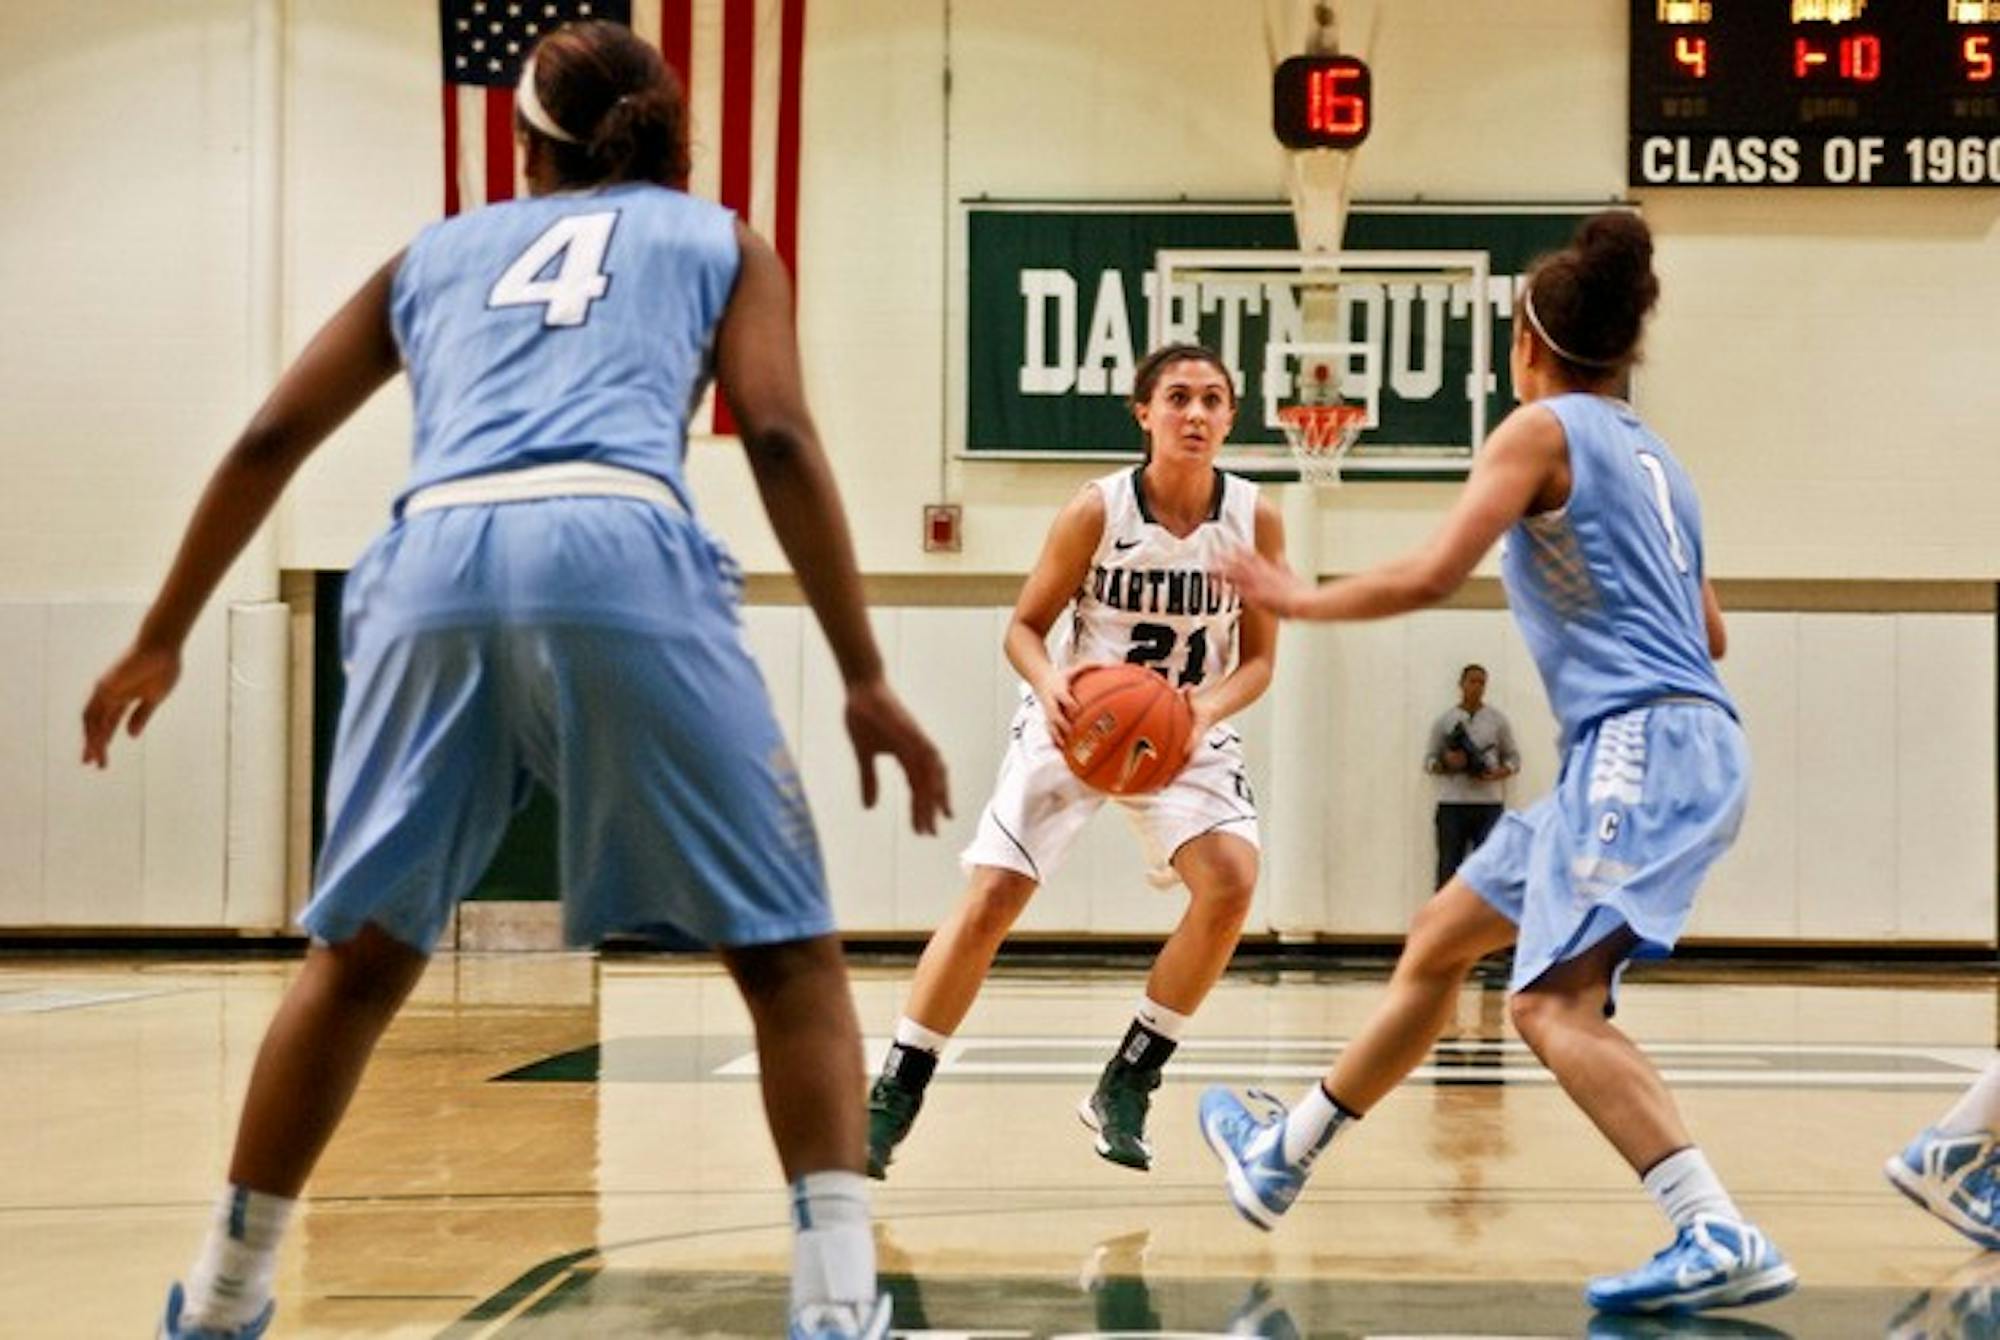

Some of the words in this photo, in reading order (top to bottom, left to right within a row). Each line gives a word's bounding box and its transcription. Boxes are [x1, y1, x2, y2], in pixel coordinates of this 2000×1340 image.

[1675, 36, 1706, 78] 4
[1963, 36, 1992, 80] 5
[1309, 67, 1363, 132] 16
[1642, 136, 1800, 183] CLASS
[1824, 136, 1884, 183] OF
[486, 208, 622, 331] 4
[1019, 269, 1530, 399] DARTOUT
[1636, 449, 1689, 575] 1
[1094, 566, 1243, 616] DARTMOU
[1125, 621, 1208, 688] 21
[1599, 810, 1621, 844] C
